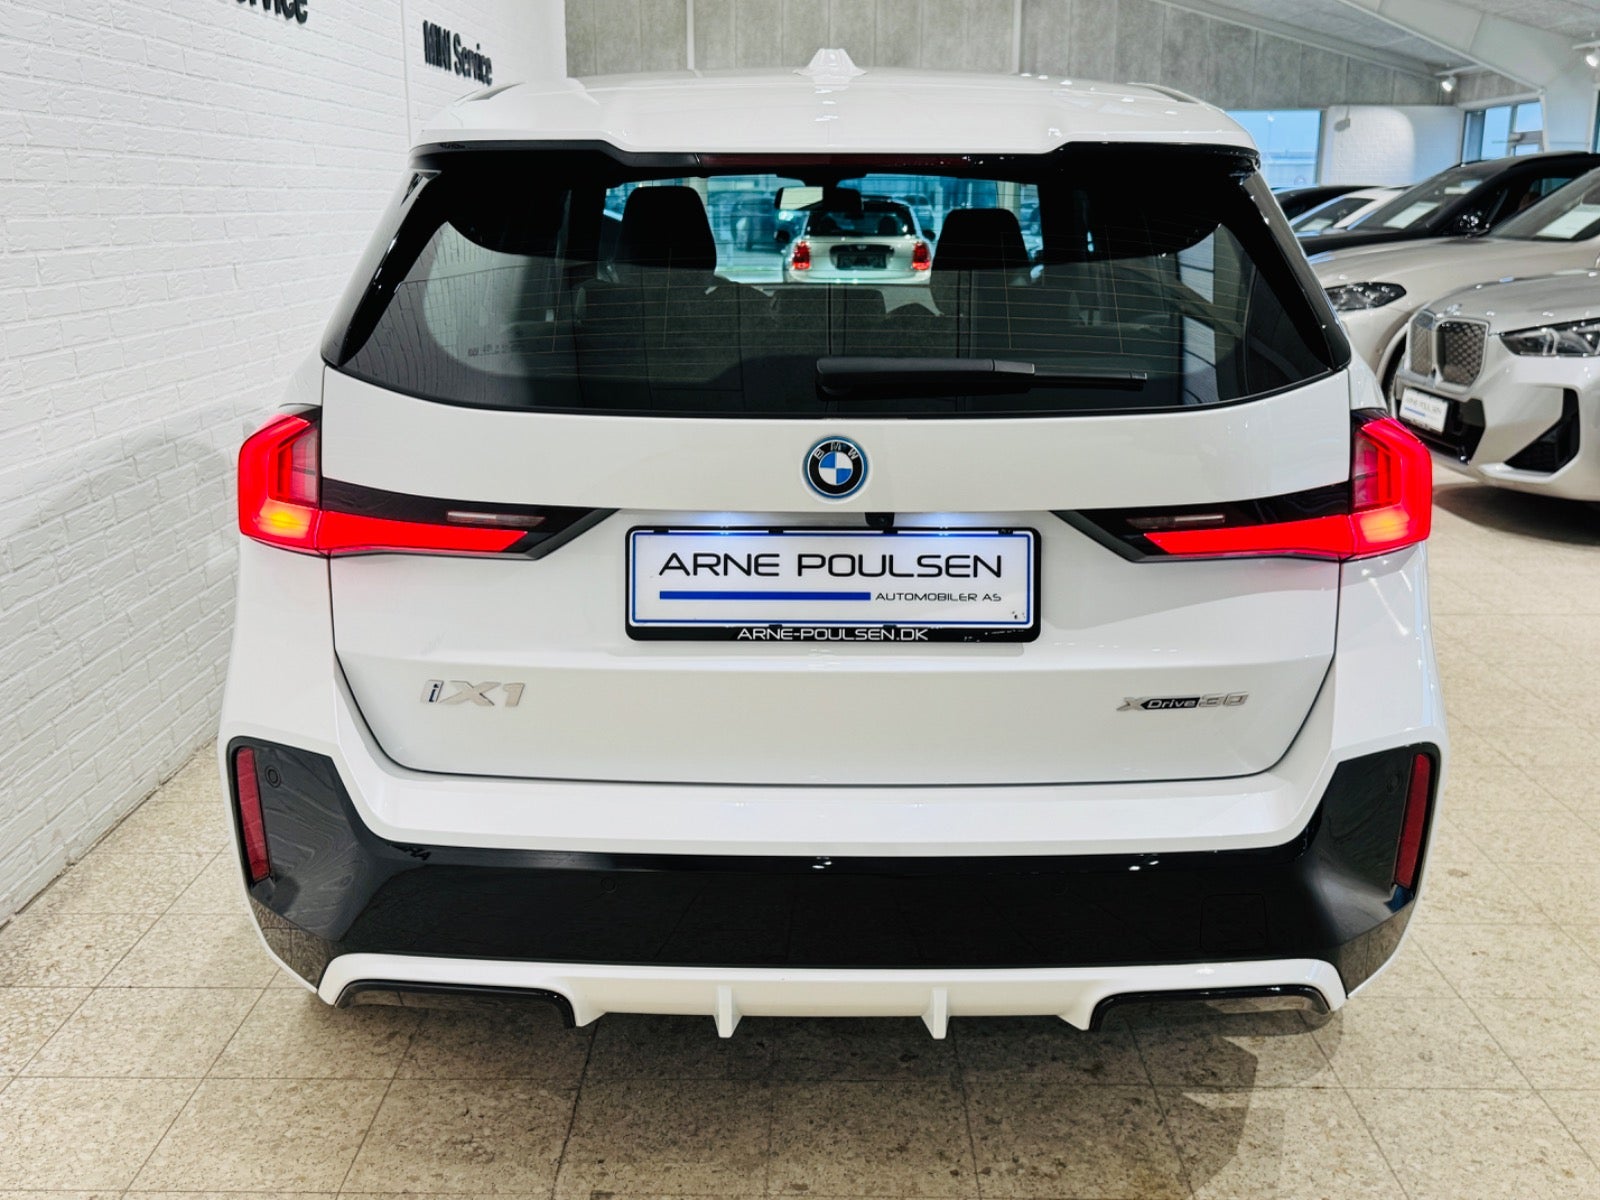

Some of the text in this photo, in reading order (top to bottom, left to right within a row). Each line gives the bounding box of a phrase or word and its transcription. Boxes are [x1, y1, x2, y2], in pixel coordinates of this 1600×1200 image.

[453, 32, 493, 86] Service
[813, 441, 859, 460] BMW
[658, 552, 1002, 578] ARNE POULSEN
[875, 592, 1002, 602] AUTOMOBILER AS
[736, 627, 929, 641] ARNE-POULSEN.DK
[420, 679, 525, 707] iX1
